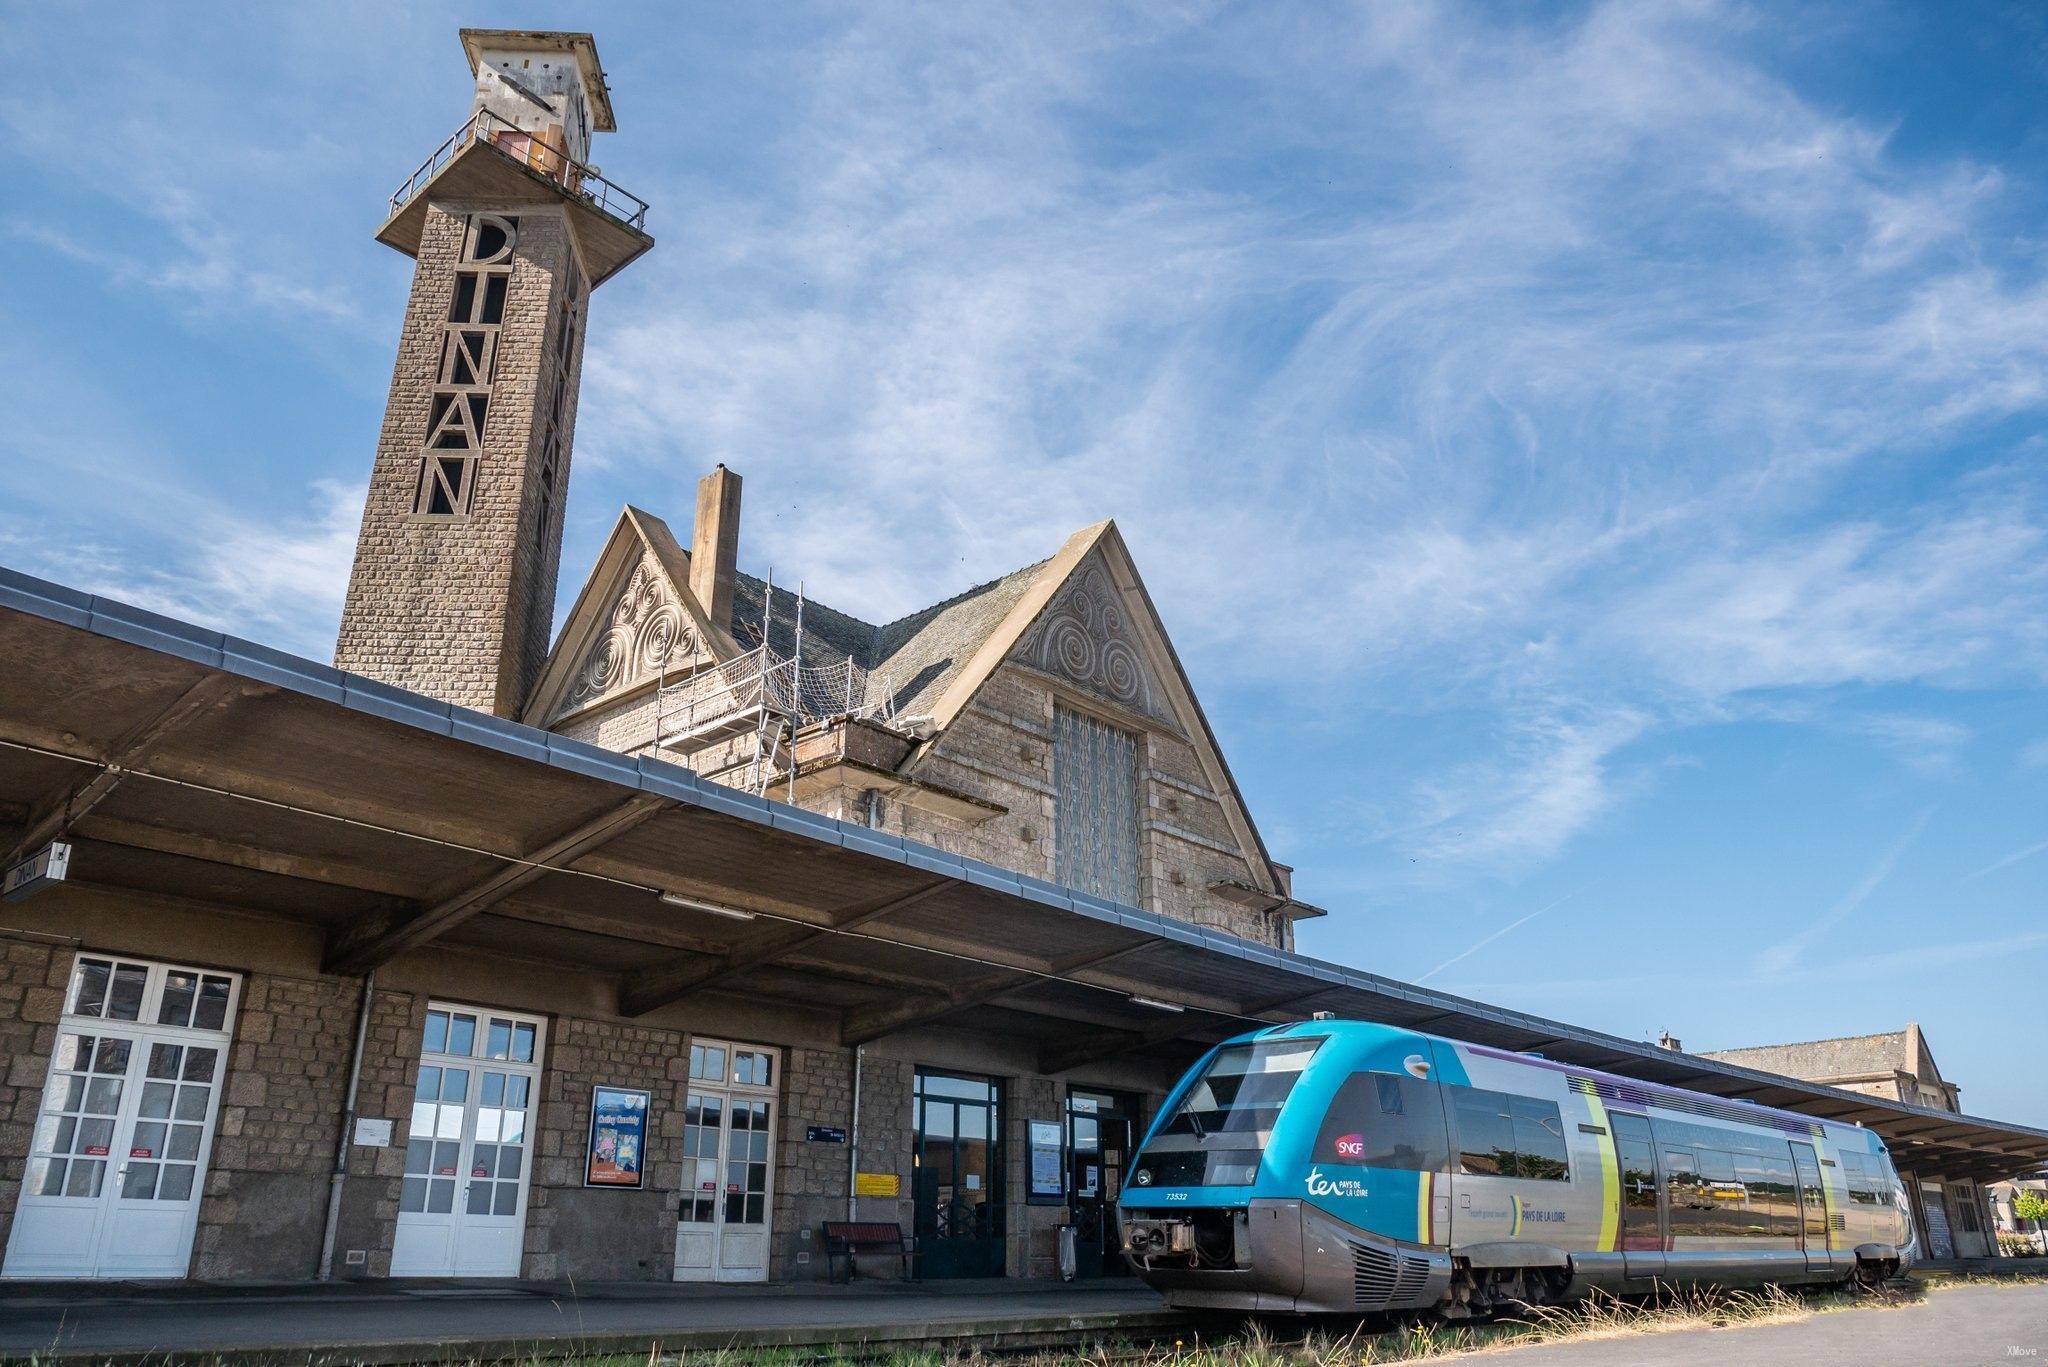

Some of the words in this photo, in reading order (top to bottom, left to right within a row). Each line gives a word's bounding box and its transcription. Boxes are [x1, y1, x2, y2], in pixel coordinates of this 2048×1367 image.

[414, 213, 517, 516] DINAN
[1338, 1141, 1364, 1155] SNCF
[1304, 1165, 1345, 1196] ter
[1339, 1181, 1353, 1189] PAYS
[1353, 1181, 1361, 1189] DE
[1166, 1193, 1188, 1201] 73532
[1346, 1189, 1353, 1197] LA
[1353, 1189, 1369, 1197] LOIRE
[1522, 1209, 1536, 1221] PAYS
[1536, 1210, 1544, 1222] DE
[1544, 1210, 1551, 1222] LA
[1551, 1211, 1566, 1223] LOIRE
